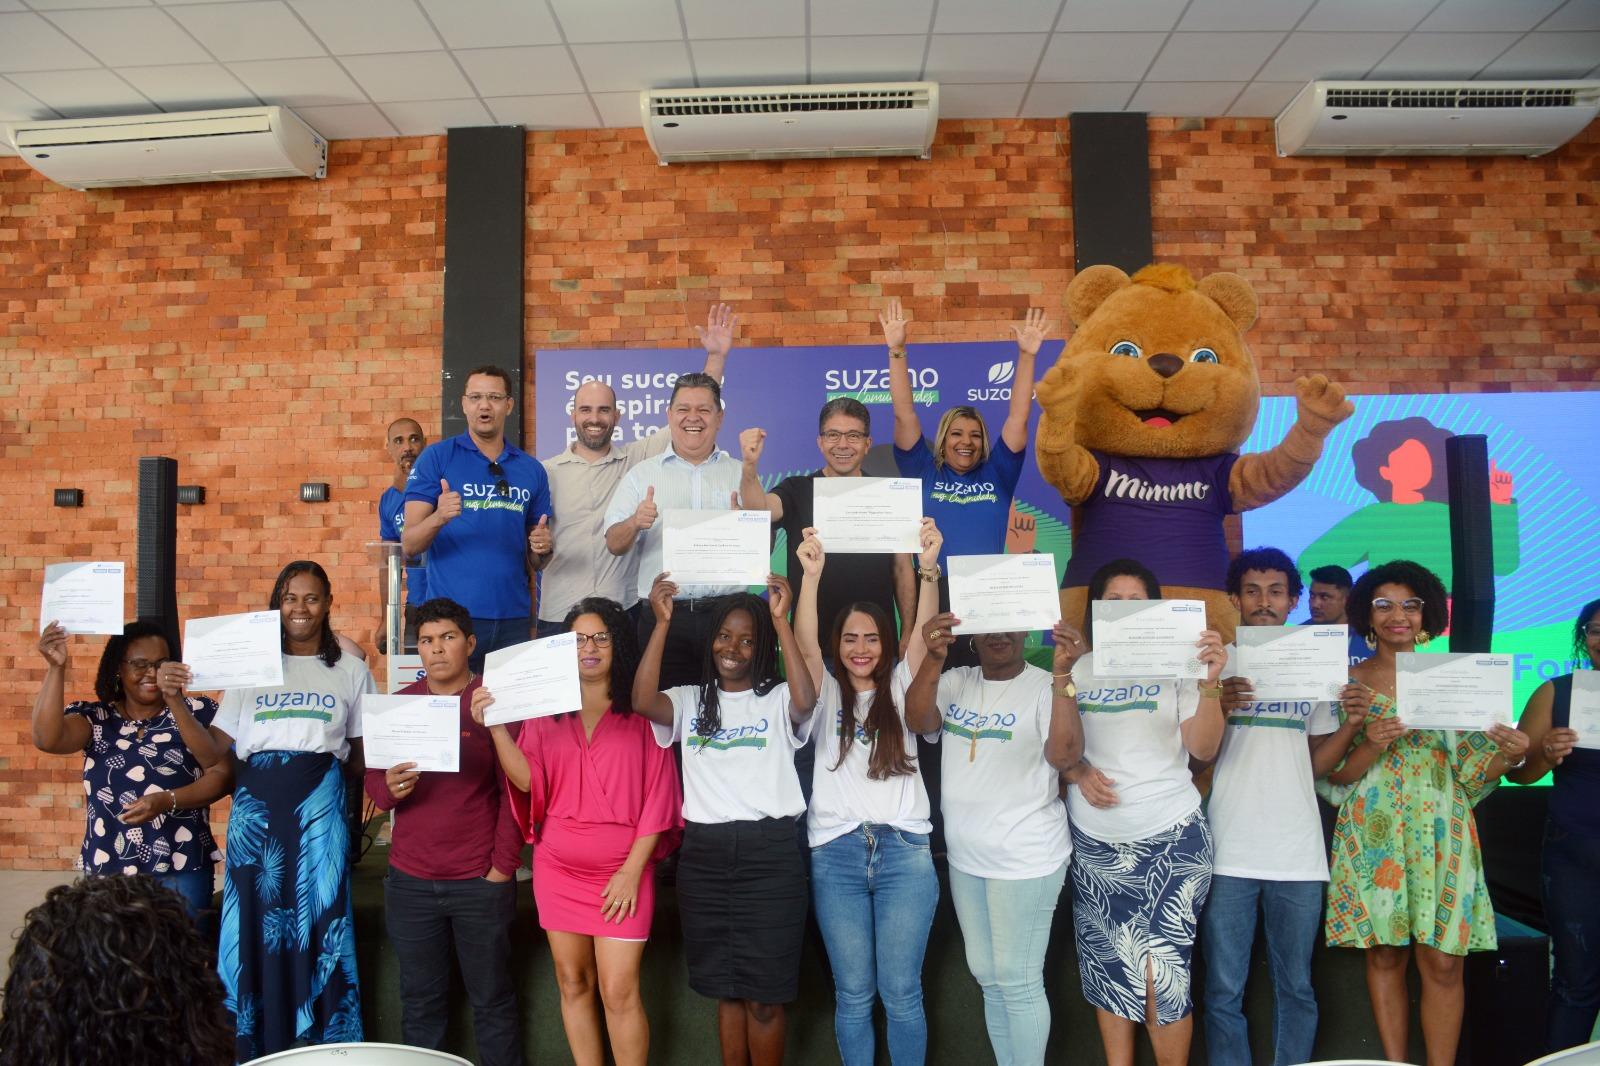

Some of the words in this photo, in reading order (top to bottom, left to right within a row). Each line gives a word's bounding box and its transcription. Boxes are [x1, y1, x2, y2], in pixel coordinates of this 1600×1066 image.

[967, 388, 1037, 401] suza
[566, 425, 624, 449] pa
[463, 483, 531, 502] suzno
[933, 481, 995, 494] suzano
[1104, 469, 1210, 502] Mimmo
[255, 692, 336, 710] suzano
[1077, 684, 1161, 702] suzano
[945, 703, 1016, 728] suzano
[689, 717, 769, 741] szano
